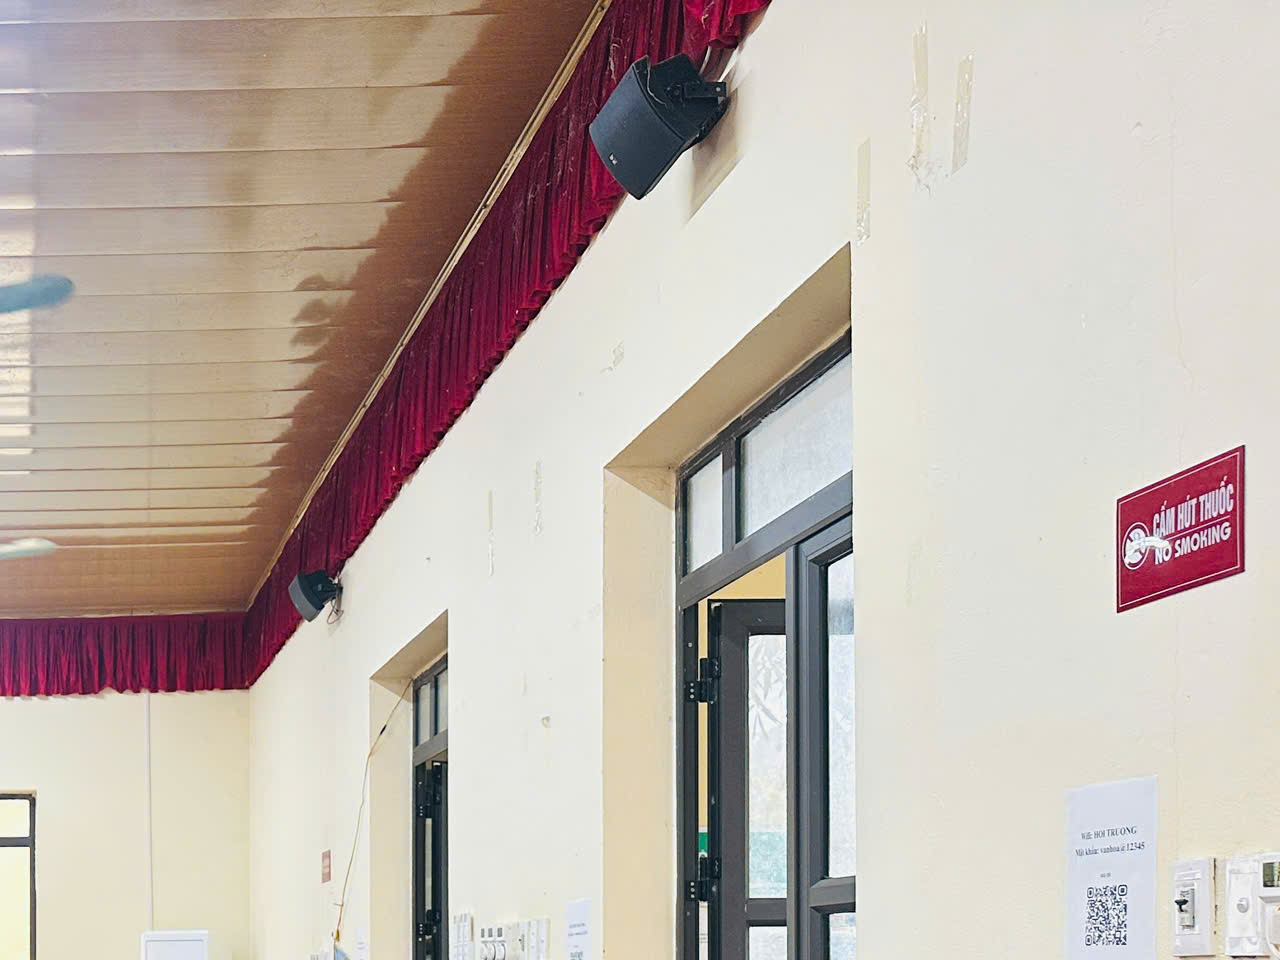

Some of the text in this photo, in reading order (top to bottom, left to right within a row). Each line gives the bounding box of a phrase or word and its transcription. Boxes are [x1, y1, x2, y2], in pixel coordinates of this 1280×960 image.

[1152, 475, 1234, 538] CẤM HÚT THUỐC
[1154, 521, 1232, 565] NO SMOKING
